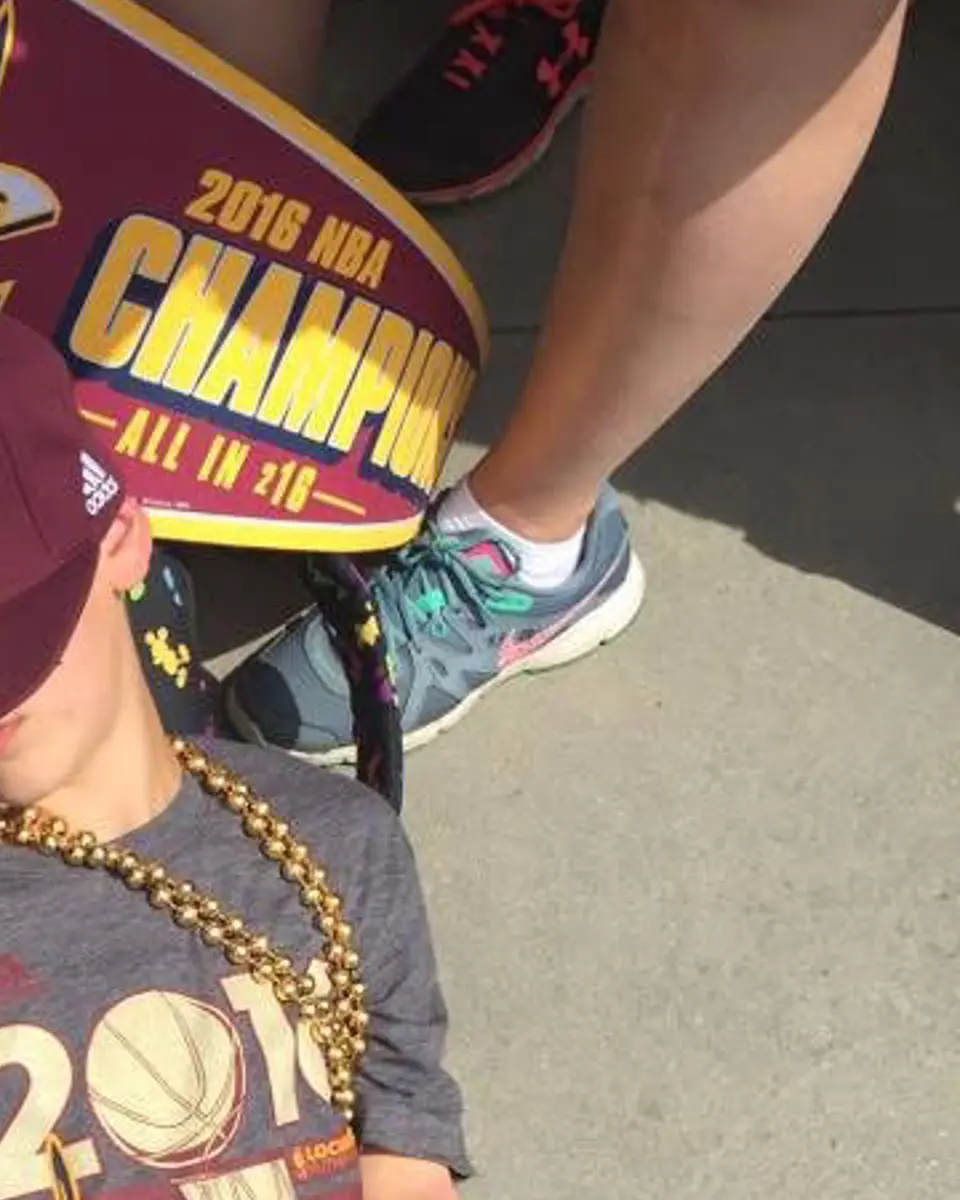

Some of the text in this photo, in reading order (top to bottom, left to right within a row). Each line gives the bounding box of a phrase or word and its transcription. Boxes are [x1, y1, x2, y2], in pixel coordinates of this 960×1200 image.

[185, 169, 393, 288] 2016 NBA
[114, 408, 318, 514] ALL IN 216
